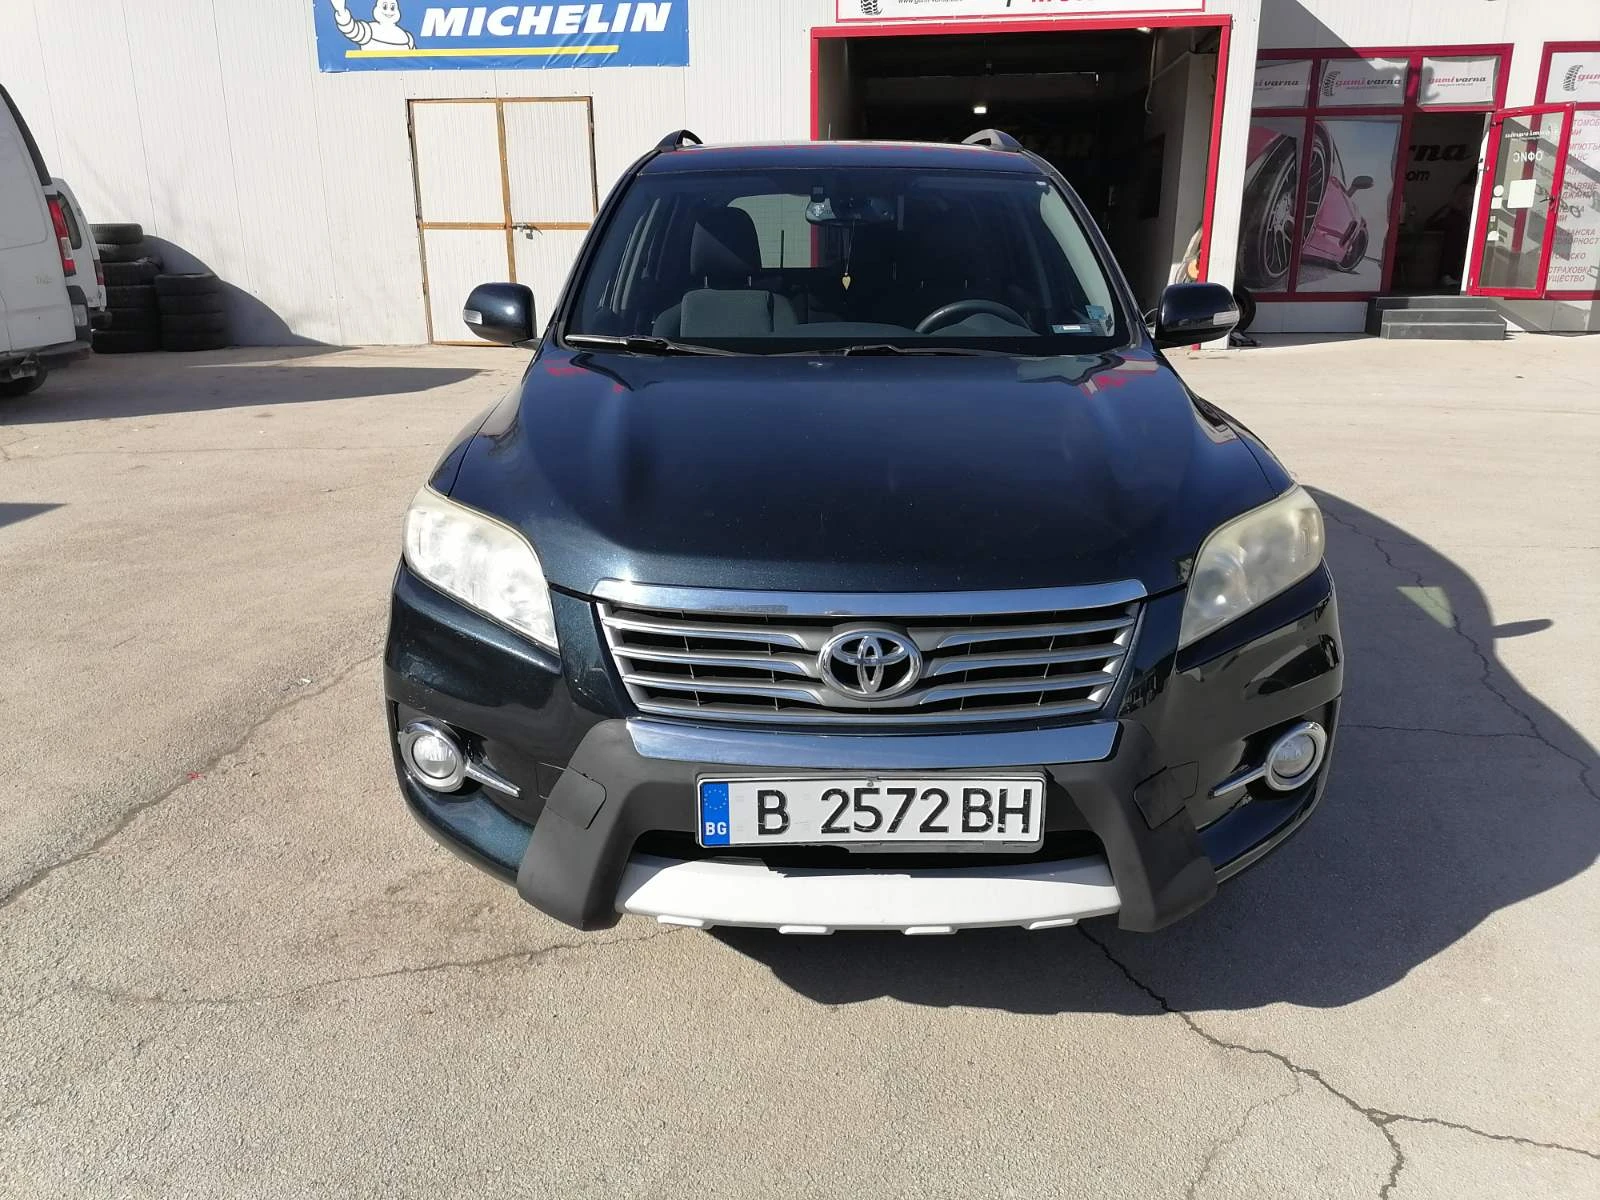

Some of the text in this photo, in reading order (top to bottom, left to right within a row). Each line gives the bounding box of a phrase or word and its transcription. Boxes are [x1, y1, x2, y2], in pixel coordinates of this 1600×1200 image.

[420, 3, 672, 37] MICHELIN
[705, 821, 728, 836] BG
[757, 787, 1031, 836] B 2572 BH
